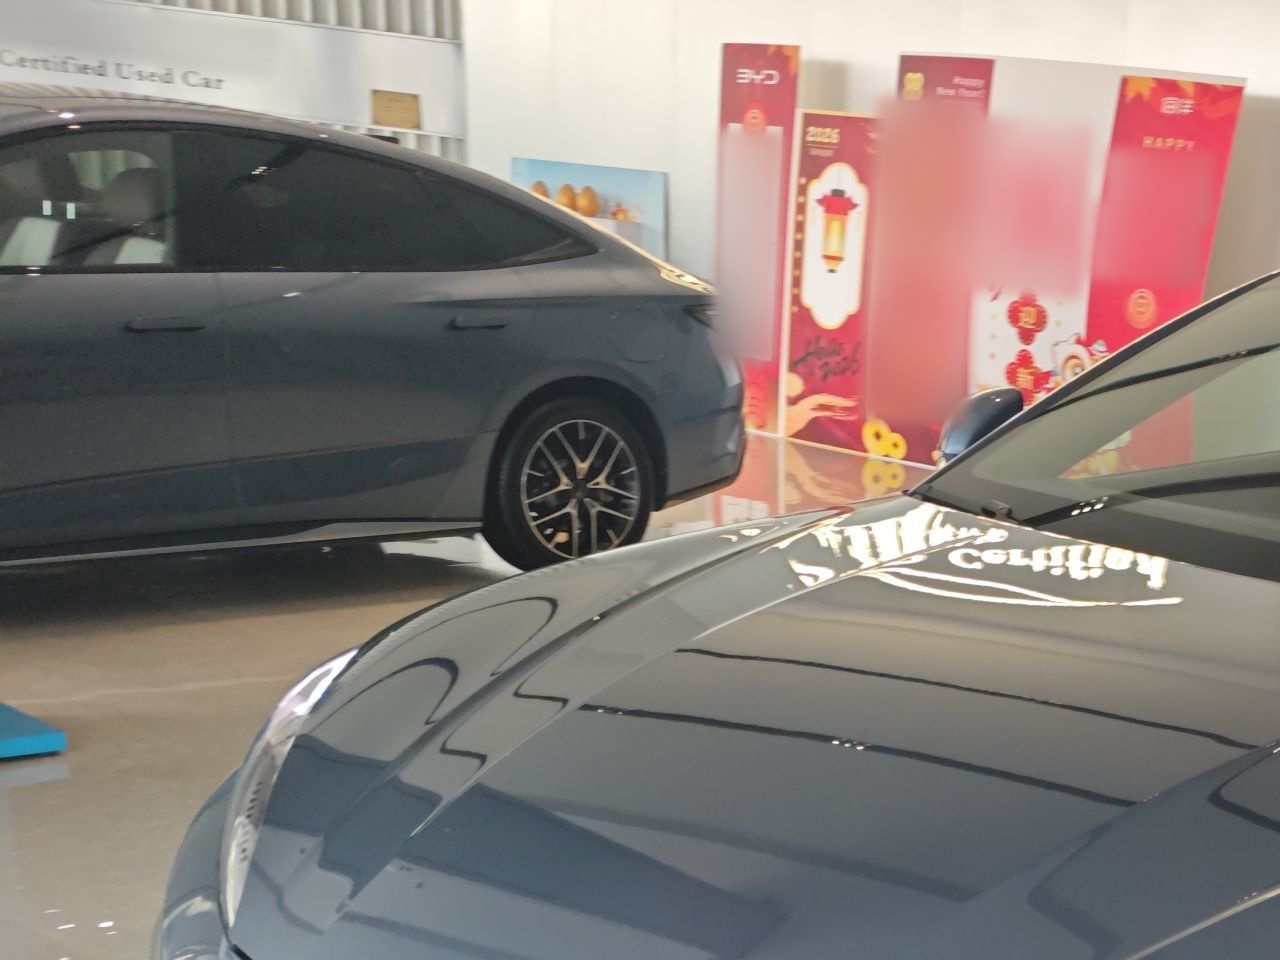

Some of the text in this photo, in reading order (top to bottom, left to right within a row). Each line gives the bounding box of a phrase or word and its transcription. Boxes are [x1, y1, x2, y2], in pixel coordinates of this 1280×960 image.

[1, 50, 225, 90] Certified Used Car
[735, 68, 780, 84] BYD
[1142, 136, 1197, 152] HAPPY
